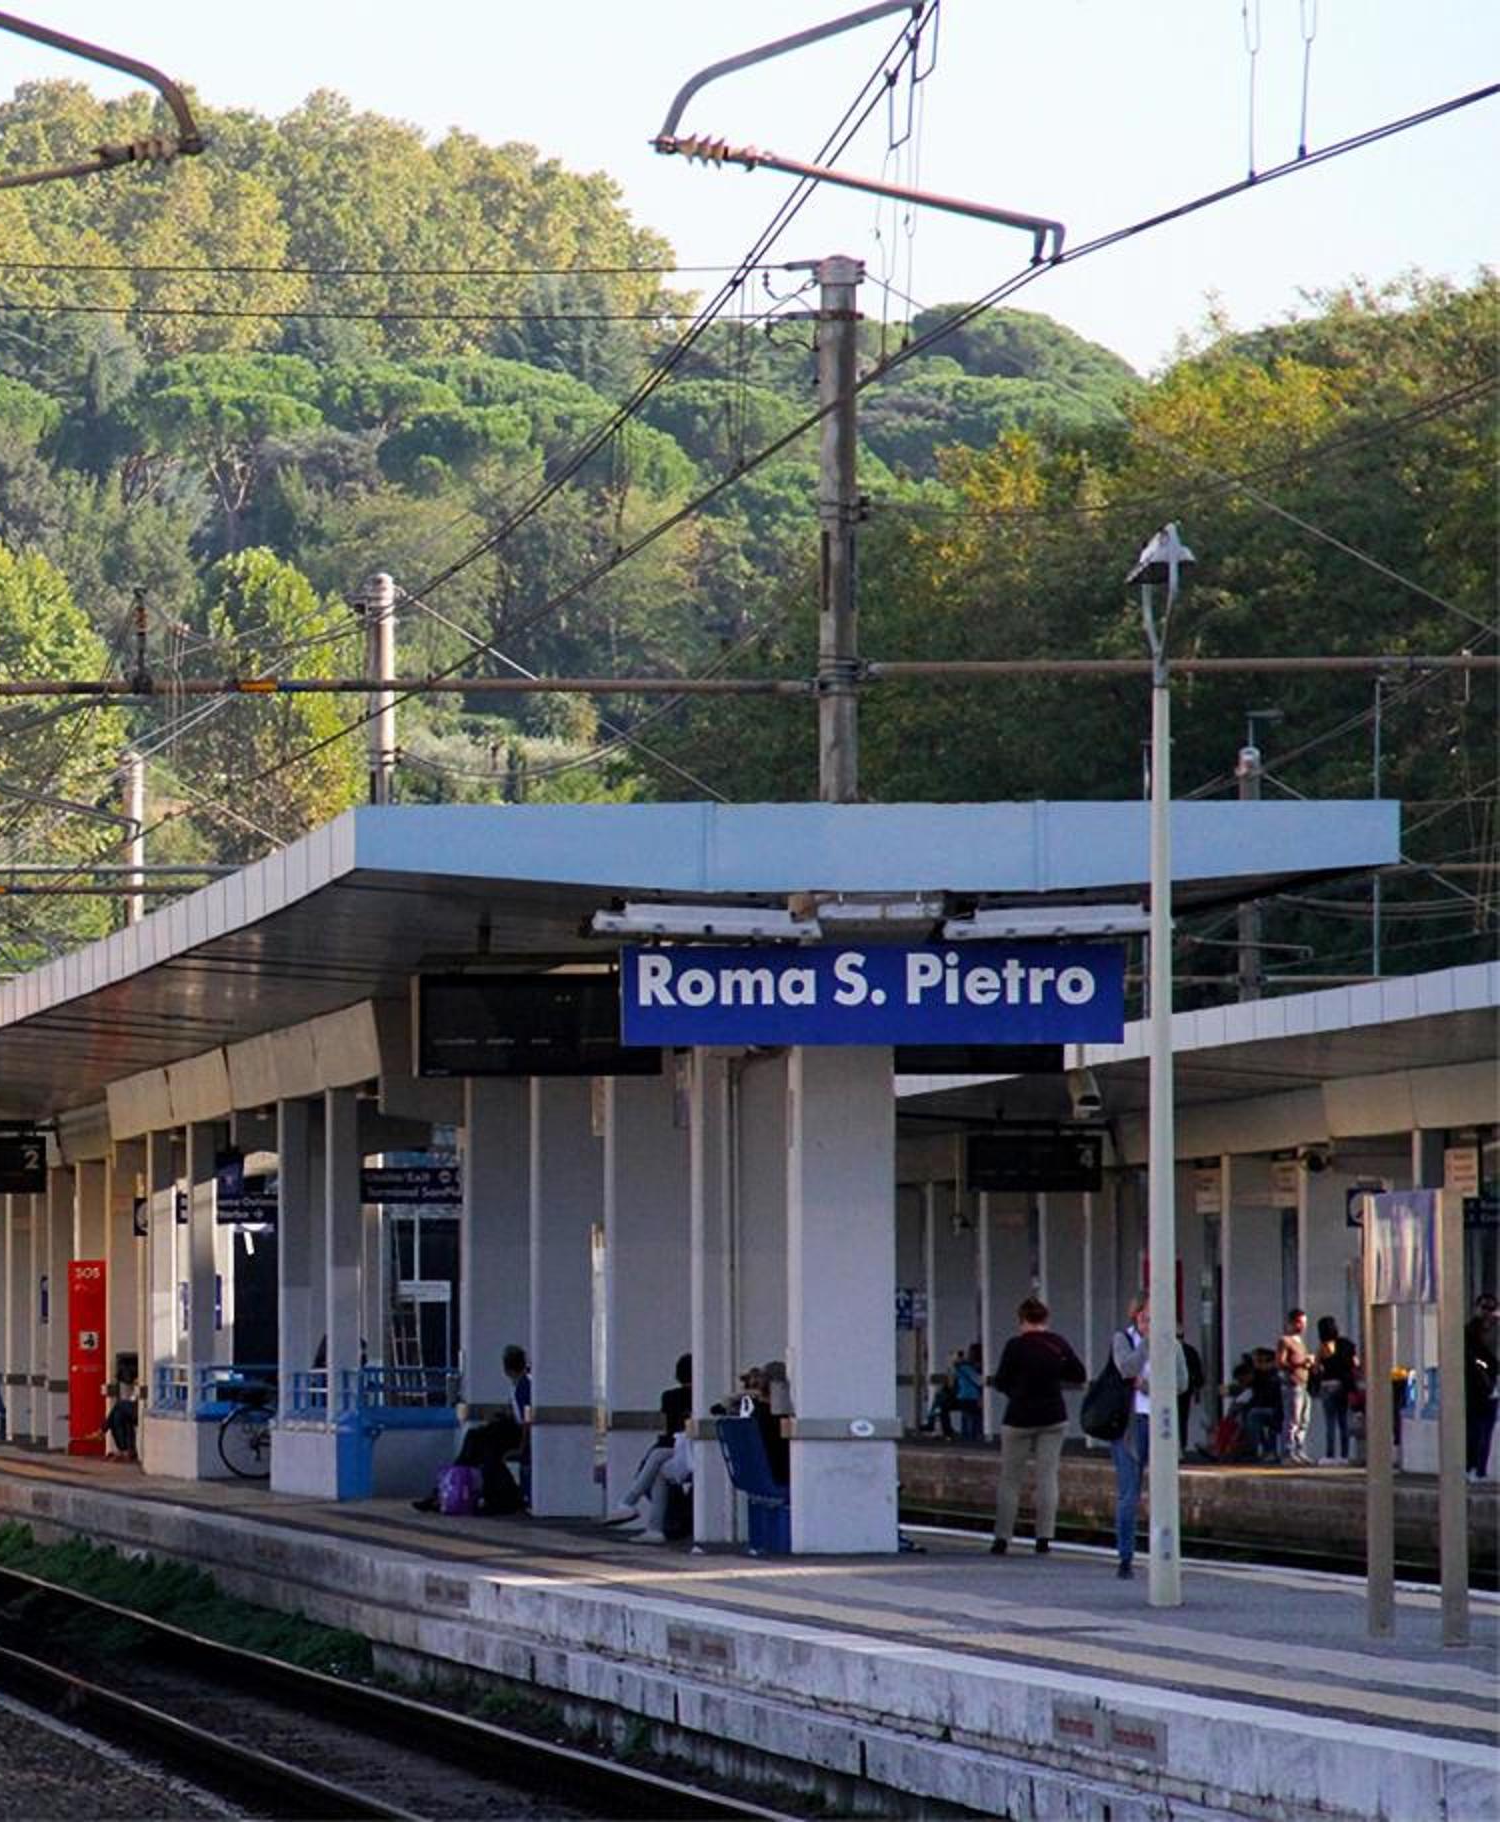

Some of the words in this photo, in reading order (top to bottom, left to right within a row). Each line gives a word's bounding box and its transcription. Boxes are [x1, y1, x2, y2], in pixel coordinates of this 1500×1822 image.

[638, 954, 817, 1007] Roma
[833, 951, 887, 1007] S.
[906, 951, 1096, 1007] Pietro
[24, 1149, 40, 1169] 2
[74, 1266, 101, 1279] SOS
